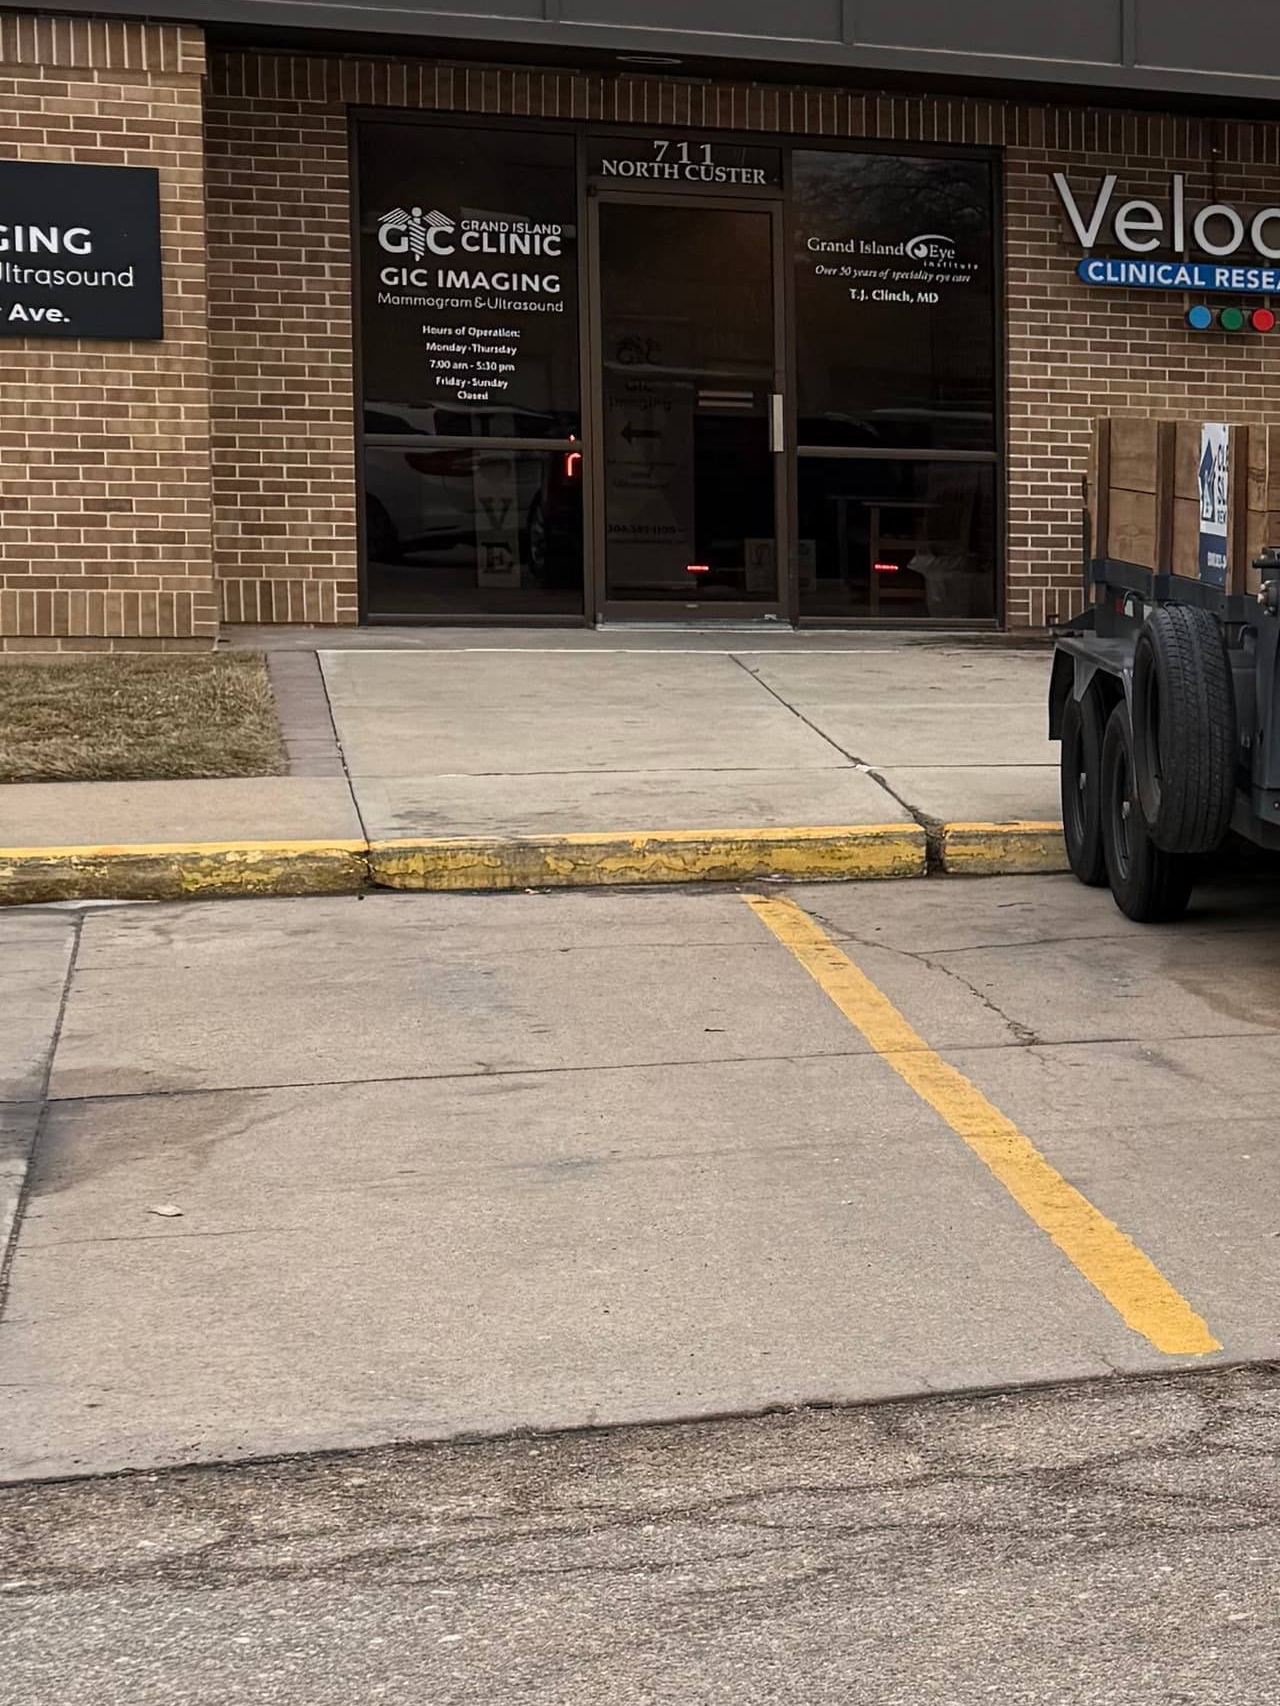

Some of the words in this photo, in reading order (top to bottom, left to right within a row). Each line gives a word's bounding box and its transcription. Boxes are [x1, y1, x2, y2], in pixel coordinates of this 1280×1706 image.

[654, 140, 714, 165] 711
[602, 159, 680, 179] NORTH
[685, 165, 767, 184] CUSTER
[461, 220, 508, 232] GRAND
[512, 222, 561, 235] ISLAND
[461, 231, 561, 256] CLINIC
[807, 237, 855, 253] Grand
[859, 240, 904, 256] Island
[929, 243, 956, 260] Eye
[0, 262, 134, 288] ltrasound
[380, 267, 428, 287] GIC
[437, 269, 561, 293] IMAGING
[815, 264, 838, 275] Over
[840, 266, 852, 276] 50
[852, 268, 878, 279] years
[879, 269, 891, 280] of
[935, 274, 951, 283] eye
[951, 274, 971, 283] care
[1088, 261, 1205, 286] CLINICAL
[378, 292, 472, 309] Mammogram
[487, 297, 563, 312] Ultrasound
[916, 292, 939, 304] MD
[8, 303, 71, 323] Ave.
[422, 325, 453, 335] Hours
[455, 326, 466, 335] of
[468, 327, 521, 338] Operation:
[452, 362, 469, 370] am
[498, 363, 515, 373] pm
[457, 391, 489, 400] Closed
